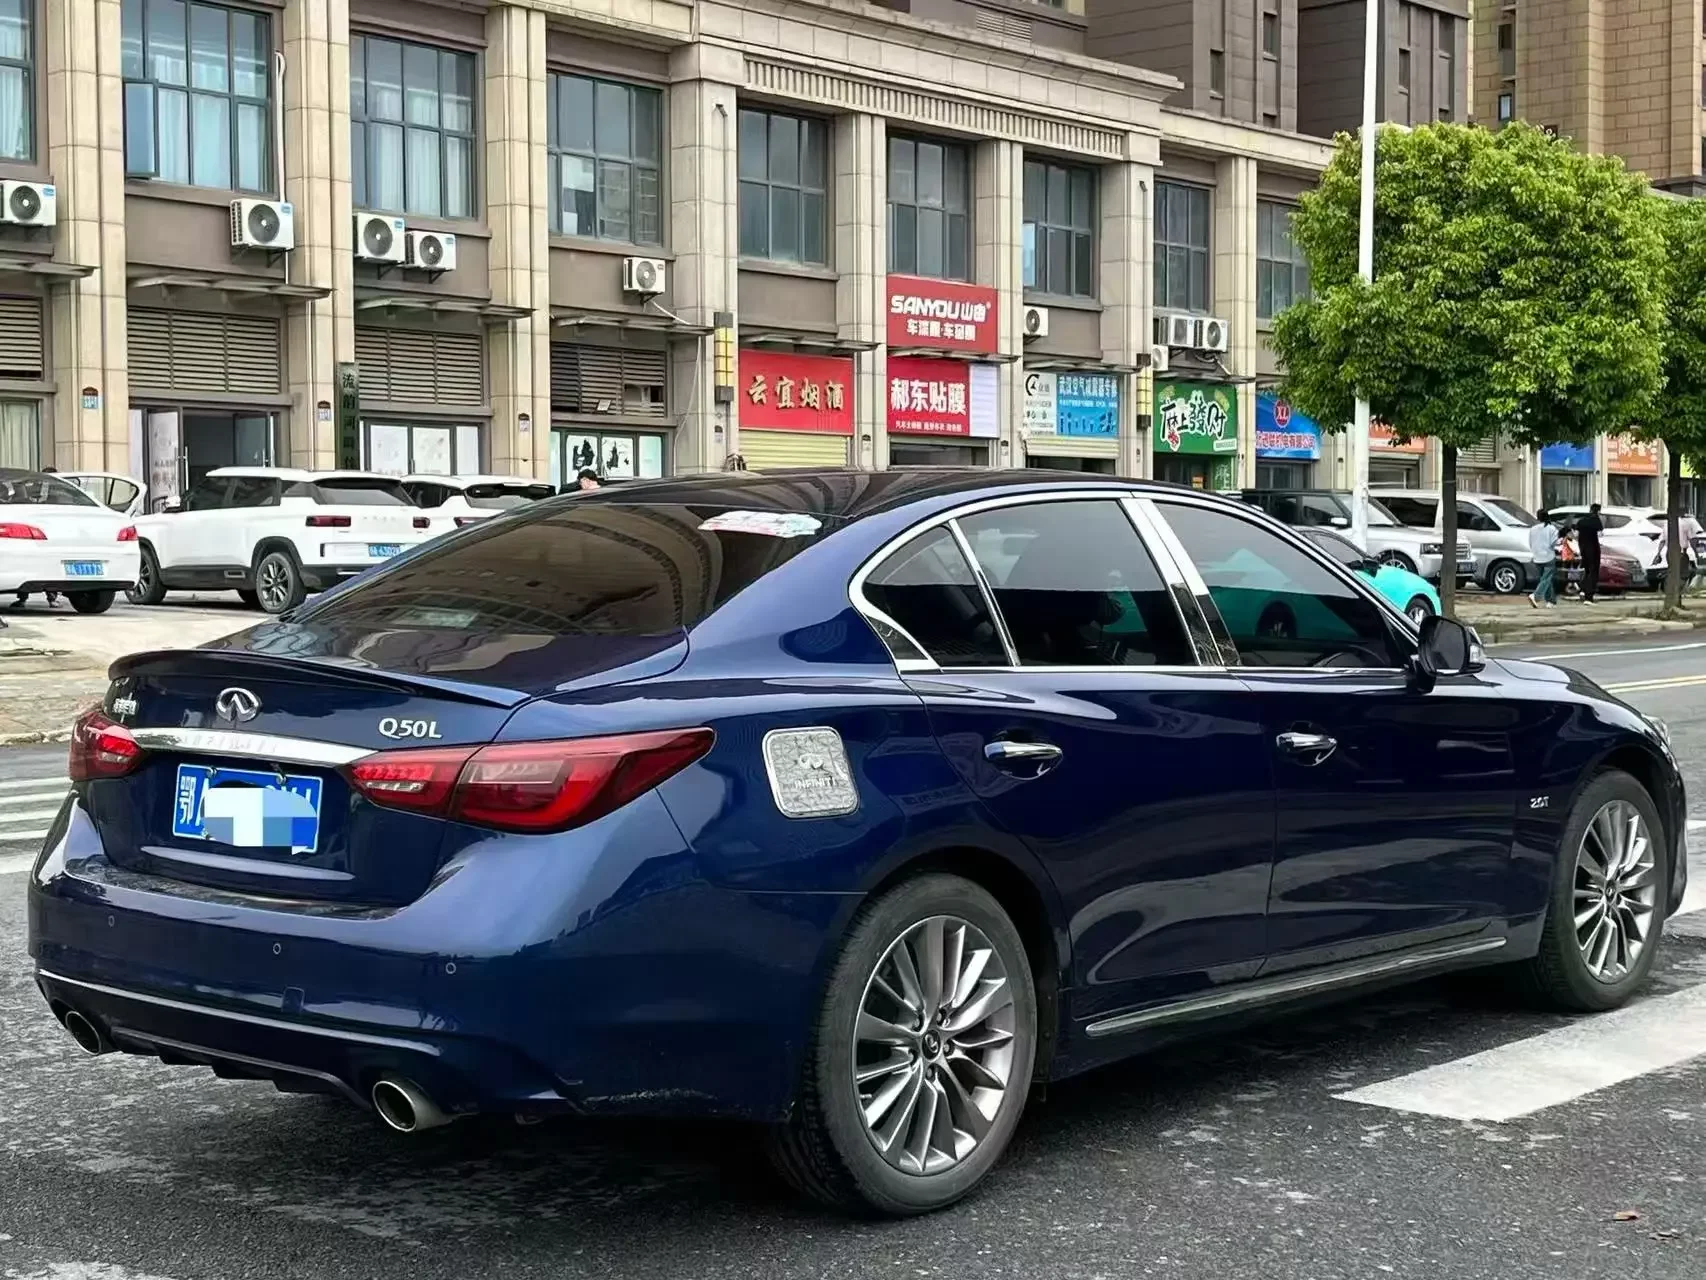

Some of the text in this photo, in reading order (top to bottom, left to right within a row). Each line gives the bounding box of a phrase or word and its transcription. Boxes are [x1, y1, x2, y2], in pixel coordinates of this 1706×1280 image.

[890, 295, 960, 320] SANYOU
[747, 375, 845, 412] 云宜烟酒
[890, 377, 967, 416] 郝东贴膜
[379, 717, 443, 740] Q50L
